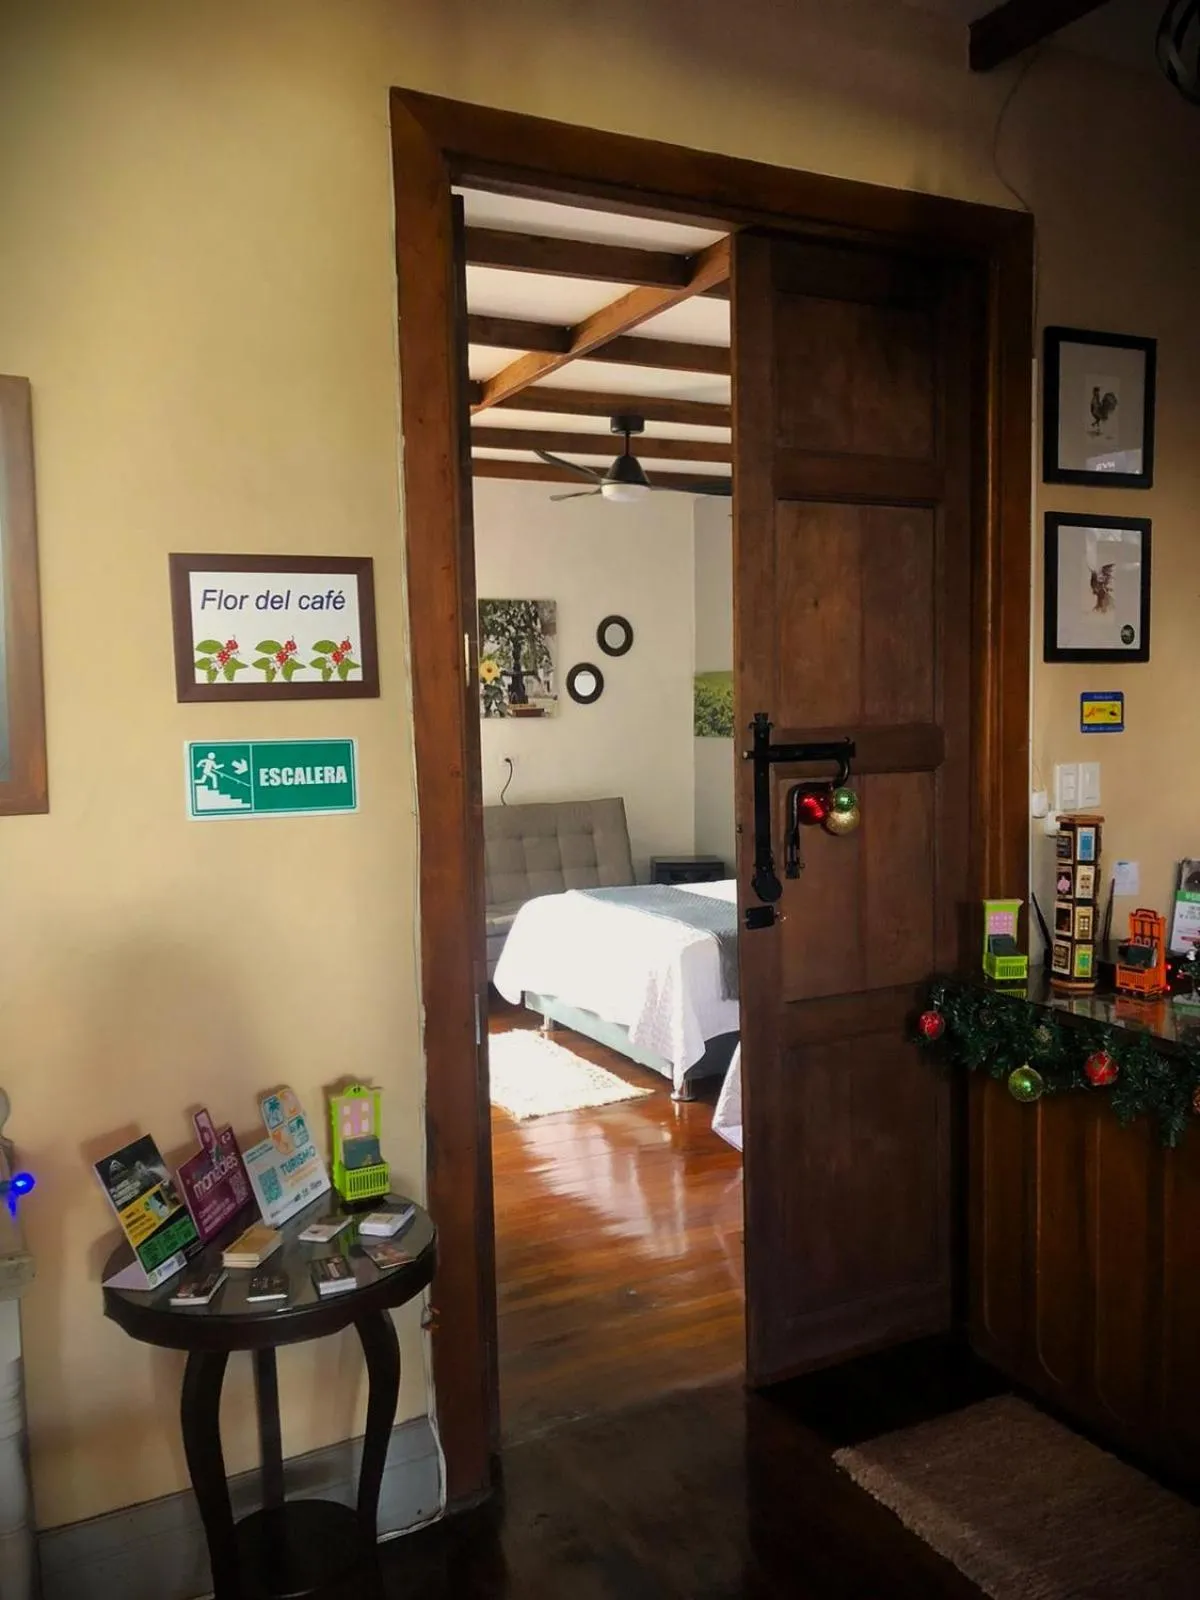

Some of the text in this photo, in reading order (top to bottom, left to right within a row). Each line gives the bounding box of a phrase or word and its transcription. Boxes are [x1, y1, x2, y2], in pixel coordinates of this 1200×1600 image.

[201, 589, 346, 611] Flor del café
[259, 766, 348, 786] ESCALERA
